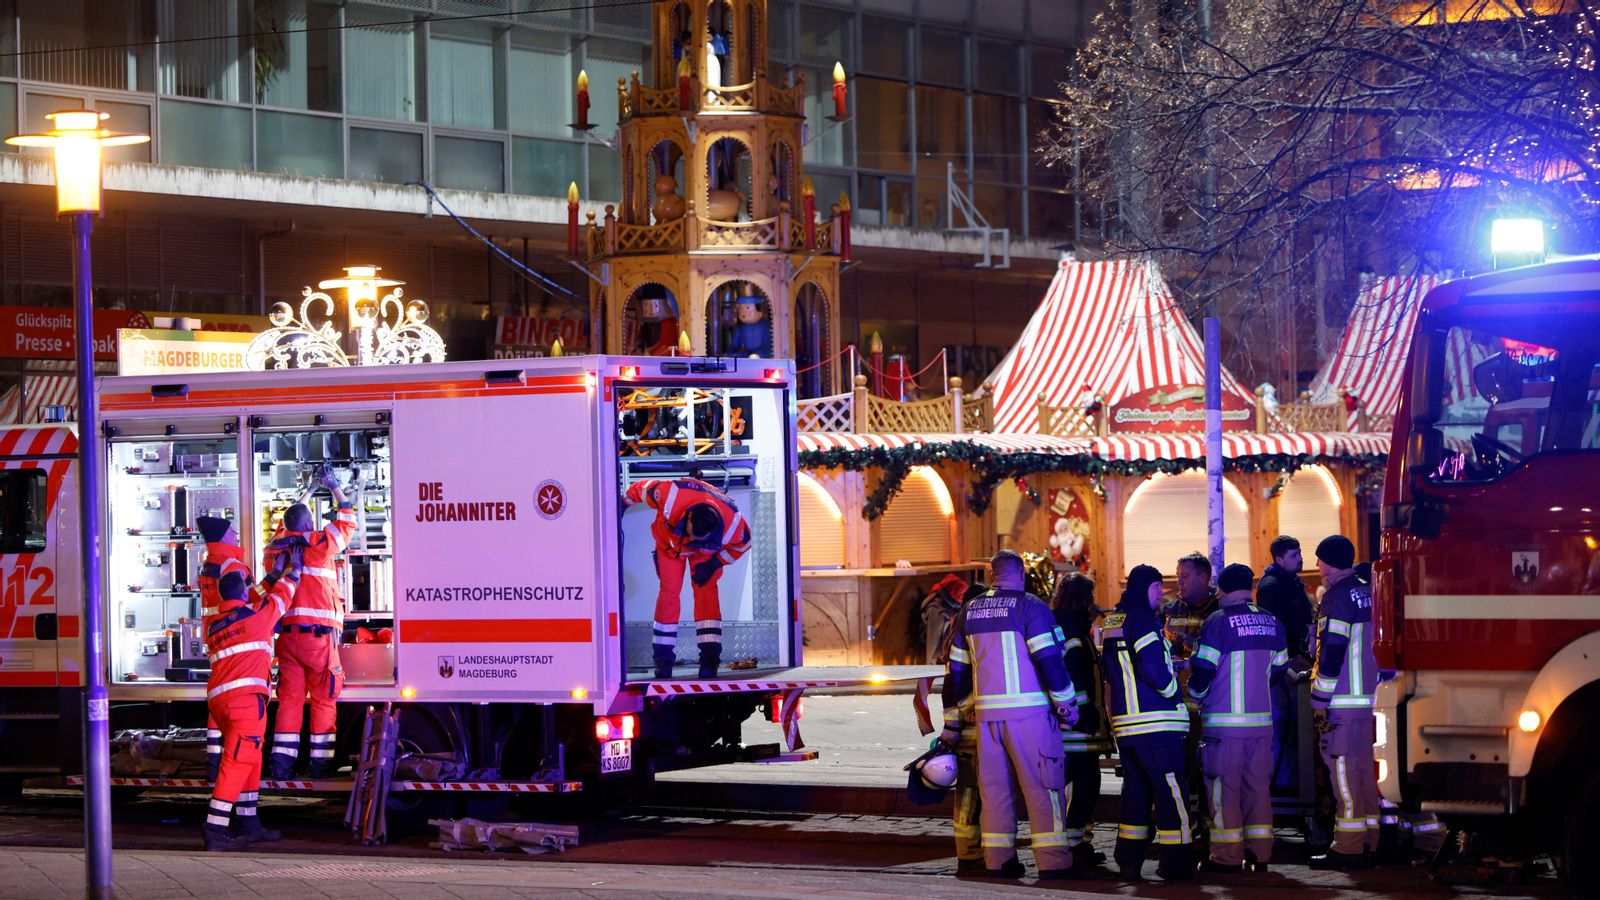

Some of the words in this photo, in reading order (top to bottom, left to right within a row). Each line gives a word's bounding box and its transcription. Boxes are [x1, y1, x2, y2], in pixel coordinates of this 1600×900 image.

[16, 313, 72, 331] Glückspilz
[16, 333, 62, 351] Presse
[144, 350, 243, 368] MAGDEBURGER
[418, 482, 443, 501] DIE
[416, 502, 516, 522] JOHANNITER
[405, 586, 584, 602] KATASTROPHENSCHUTZ
[966, 597, 1017, 609] EUERWEHR
[458, 655, 554, 665] LANDESHAUPTSTADT
[458, 669, 517, 678] MAGDEBURG
[611, 742, 620, 756] MD
[602, 757, 612, 771] KS
